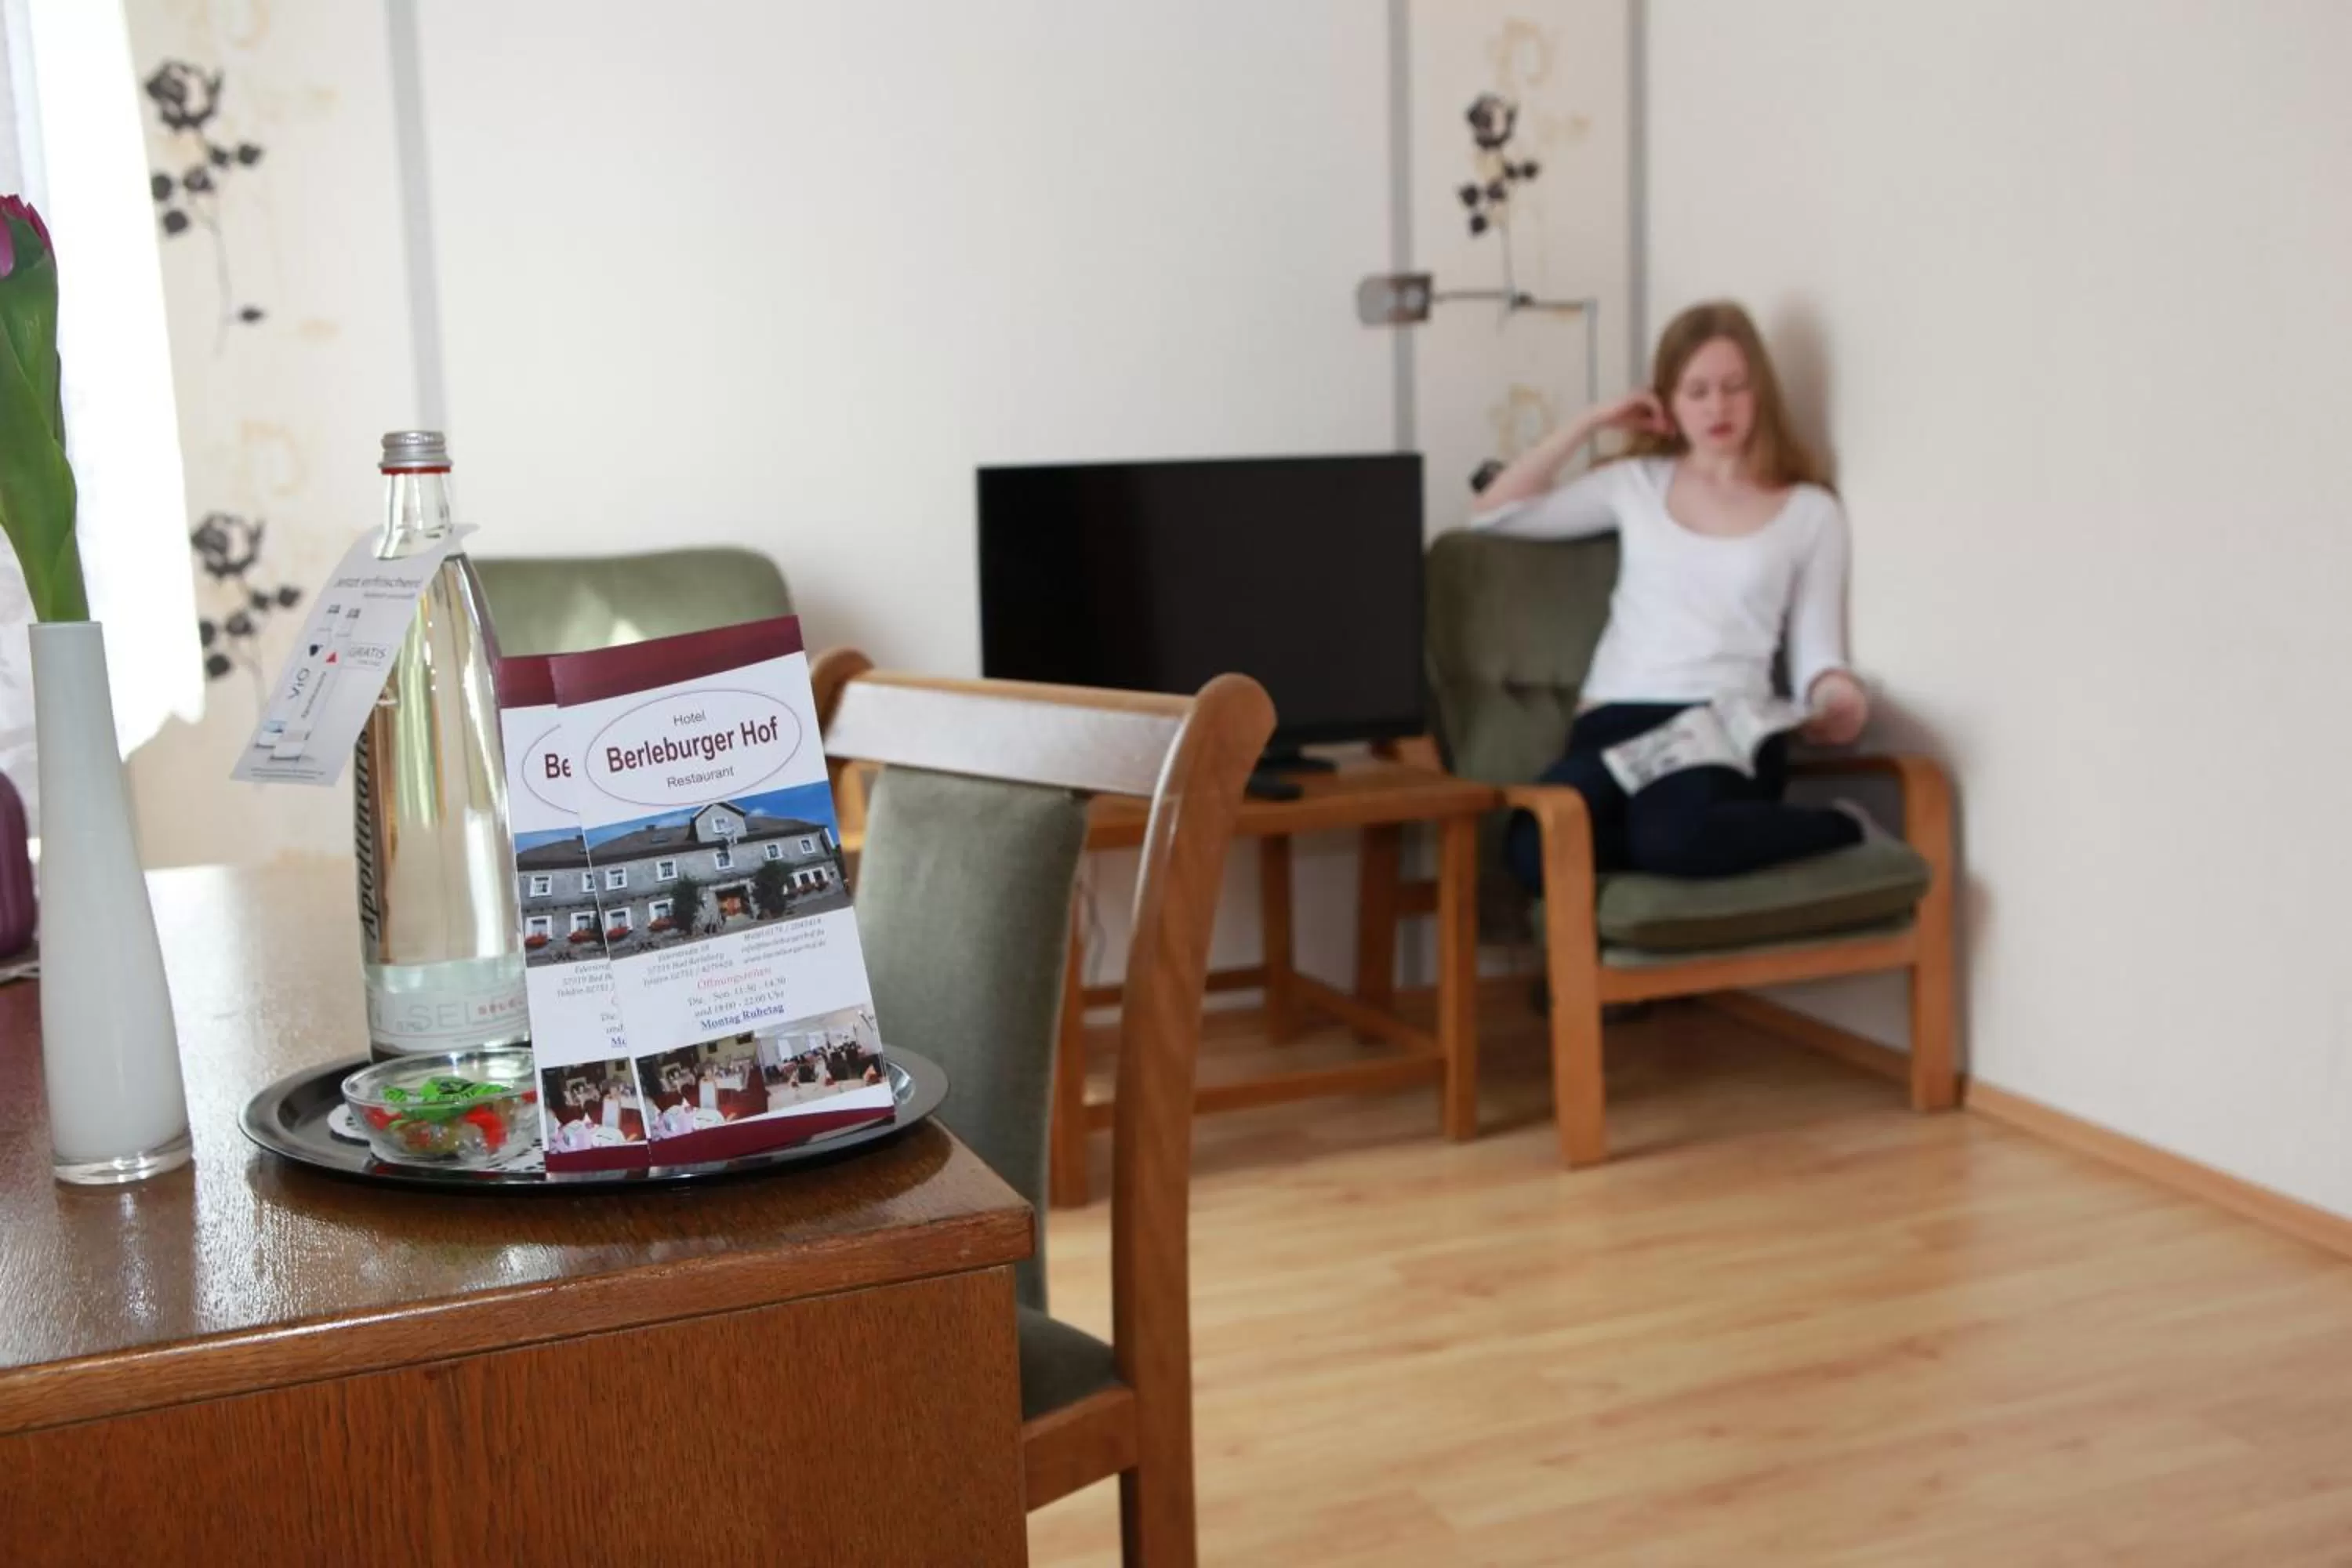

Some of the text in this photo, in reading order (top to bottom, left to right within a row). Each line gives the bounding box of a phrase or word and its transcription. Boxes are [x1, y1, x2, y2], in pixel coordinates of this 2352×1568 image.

[673, 710, 706, 726] Hotel
[606, 716, 779, 773] Berleburger Hof
[666, 765, 735, 788] Restaurant
[700, 1004, 785, 1031] Montag Ruhetag
